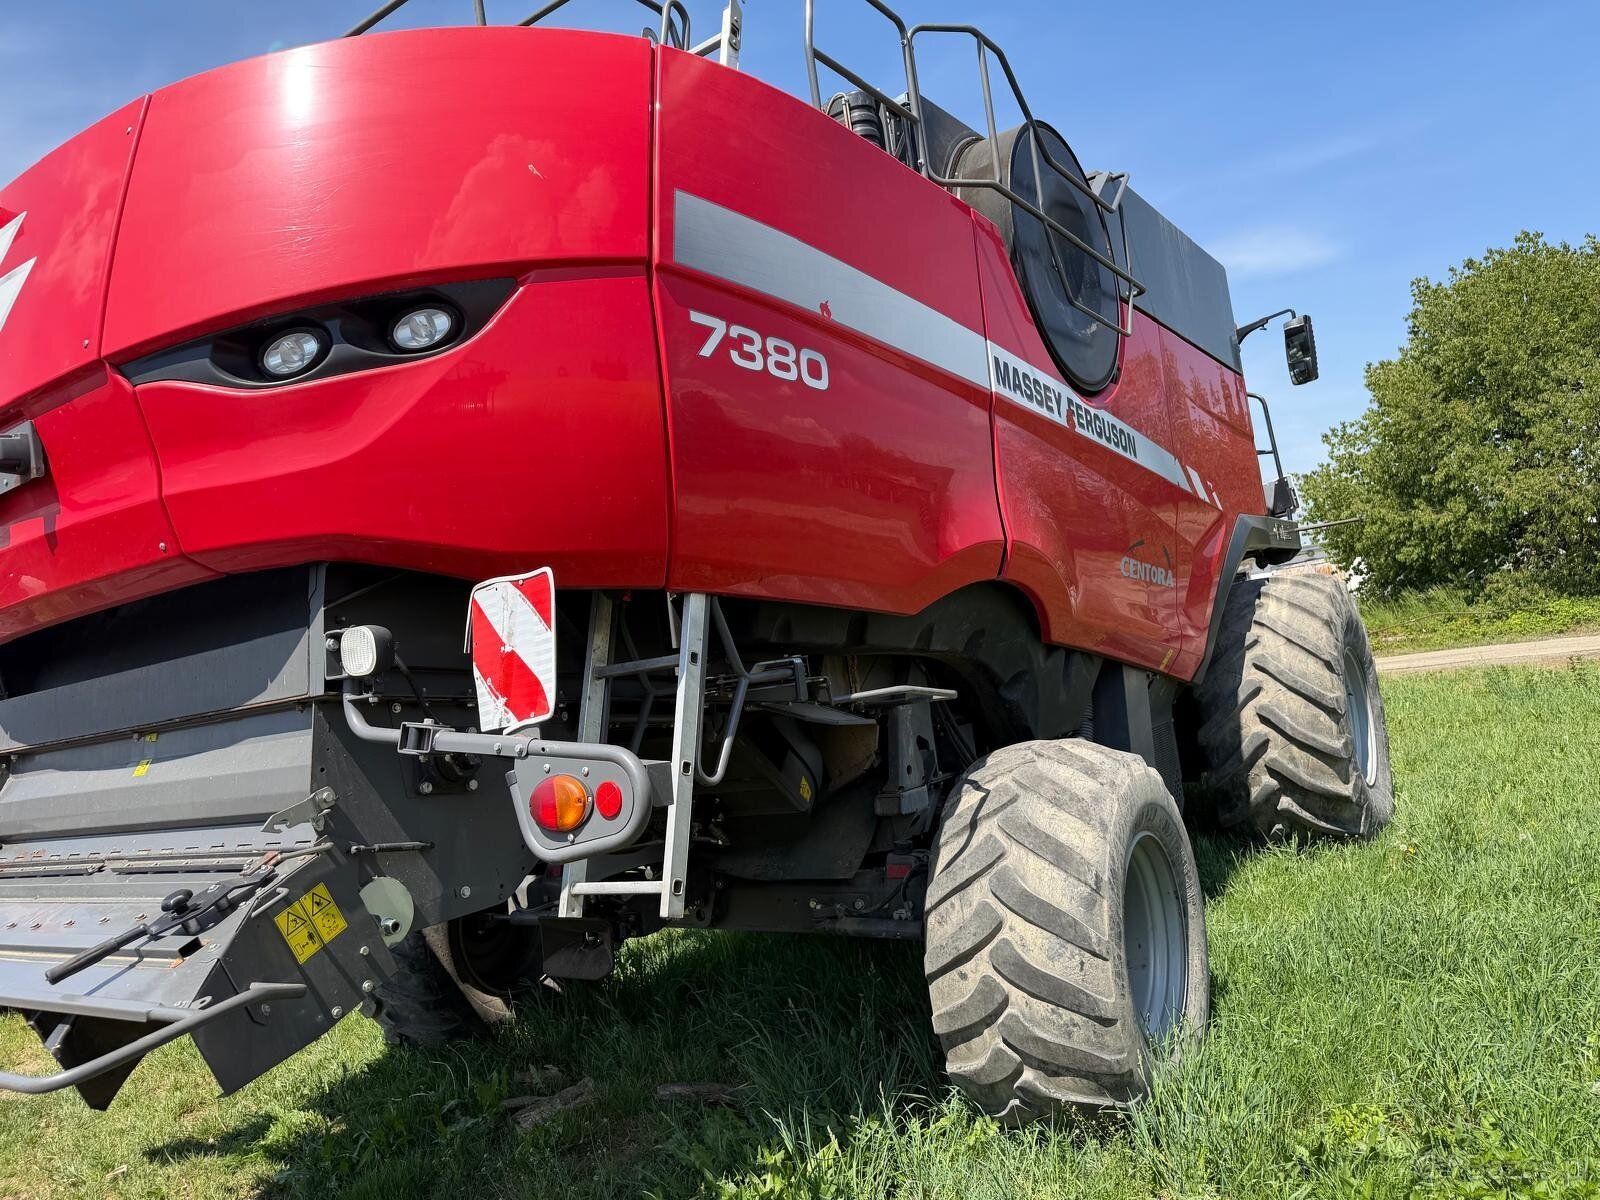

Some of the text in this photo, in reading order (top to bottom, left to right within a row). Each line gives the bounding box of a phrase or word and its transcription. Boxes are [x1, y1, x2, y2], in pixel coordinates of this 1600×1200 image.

[689, 309, 829, 391] 7380
[993, 354, 1138, 459] MASSEY FERGUSON
[1120, 555, 1175, 589] CENTORA
